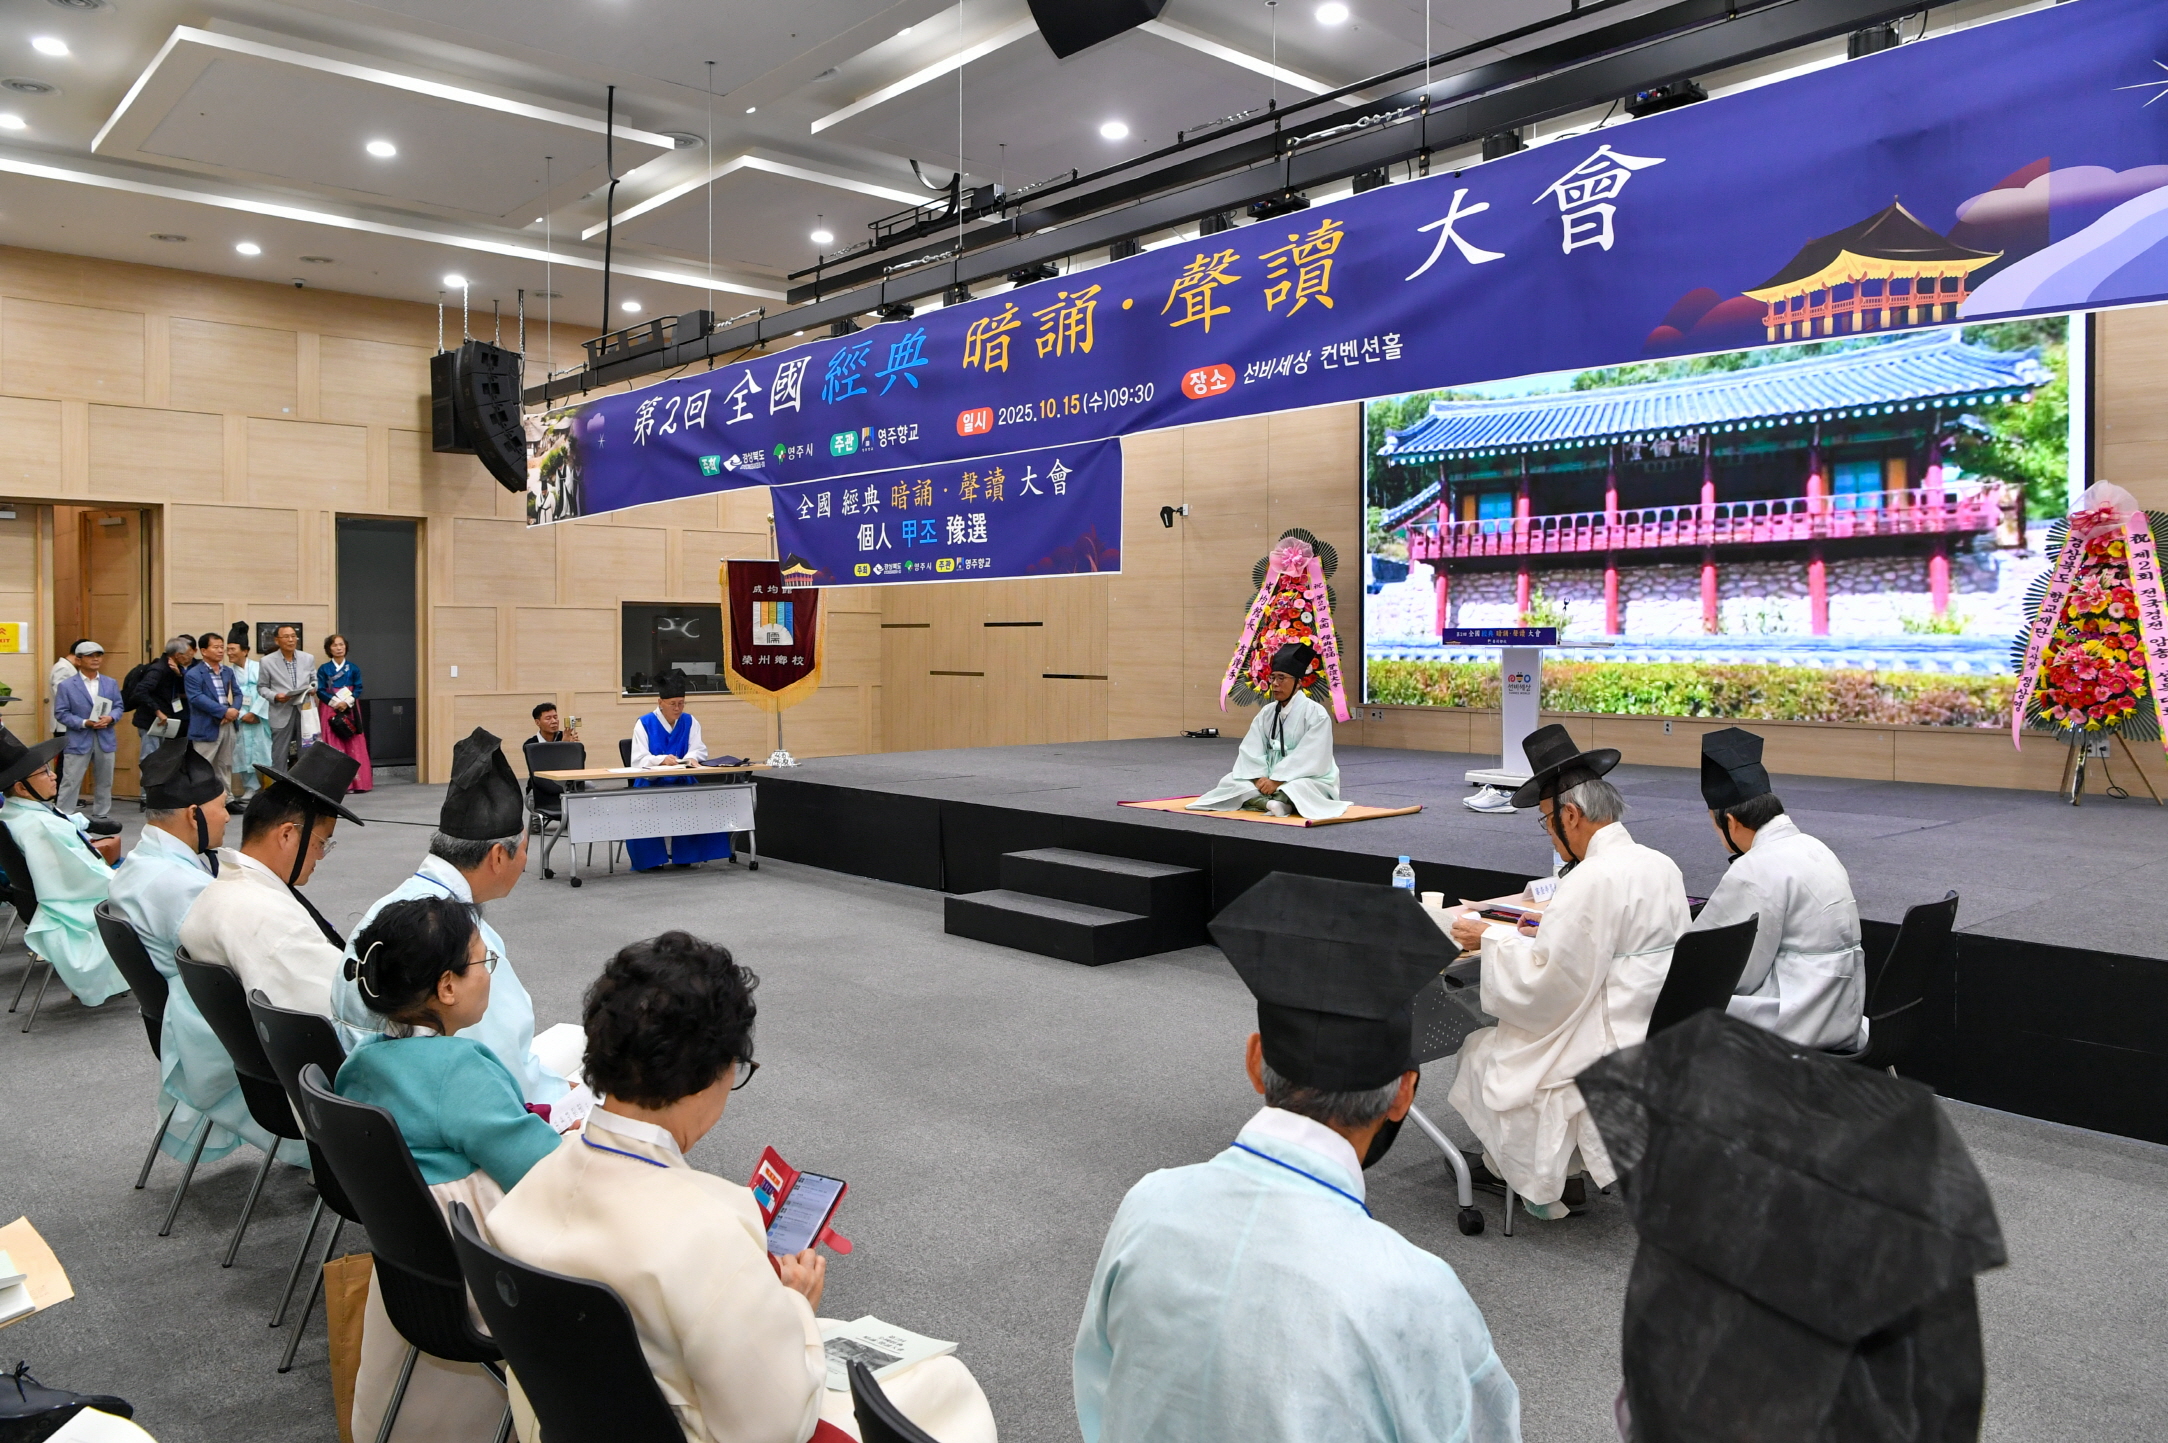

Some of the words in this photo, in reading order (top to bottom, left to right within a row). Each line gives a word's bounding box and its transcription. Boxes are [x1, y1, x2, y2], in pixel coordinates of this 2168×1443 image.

[632, 388, 712, 446] 第2回
[723, 355, 812, 425] 全國
[821, 327, 929, 405] 經典
[1404, 144, 1667, 282] 大會
[787, 442, 814, 461] 영주시
[833, 433, 855, 454] 주관
[877, 423, 919, 448] 영주향교
[963, 410, 987, 433] 일시
[1189, 368, 1227, 395] 장소
[1243, 350, 1312, 385] 선비세상
[1320, 332, 1403, 370] 컨벤션홀
[797, 491, 831, 520] 全國
[841, 483, 880, 516] 經典
[1019, 458, 1073, 497] 大會
[857, 522, 892, 552] 個人
[946, 512, 988, 546] 豫選
[914, 562, 932, 572] 영주시
[938, 560, 952, 571] 주관
[965, 558, 991, 570] 영주향교
[2052, 536, 2084, 584] 경상북도
[2133, 549, 2154, 581] 제2회
[2033, 590, 2065, 639] 향교재단
[2140, 587, 2163, 631] 전국경전
[2028, 645, 2040, 670] 이사장
